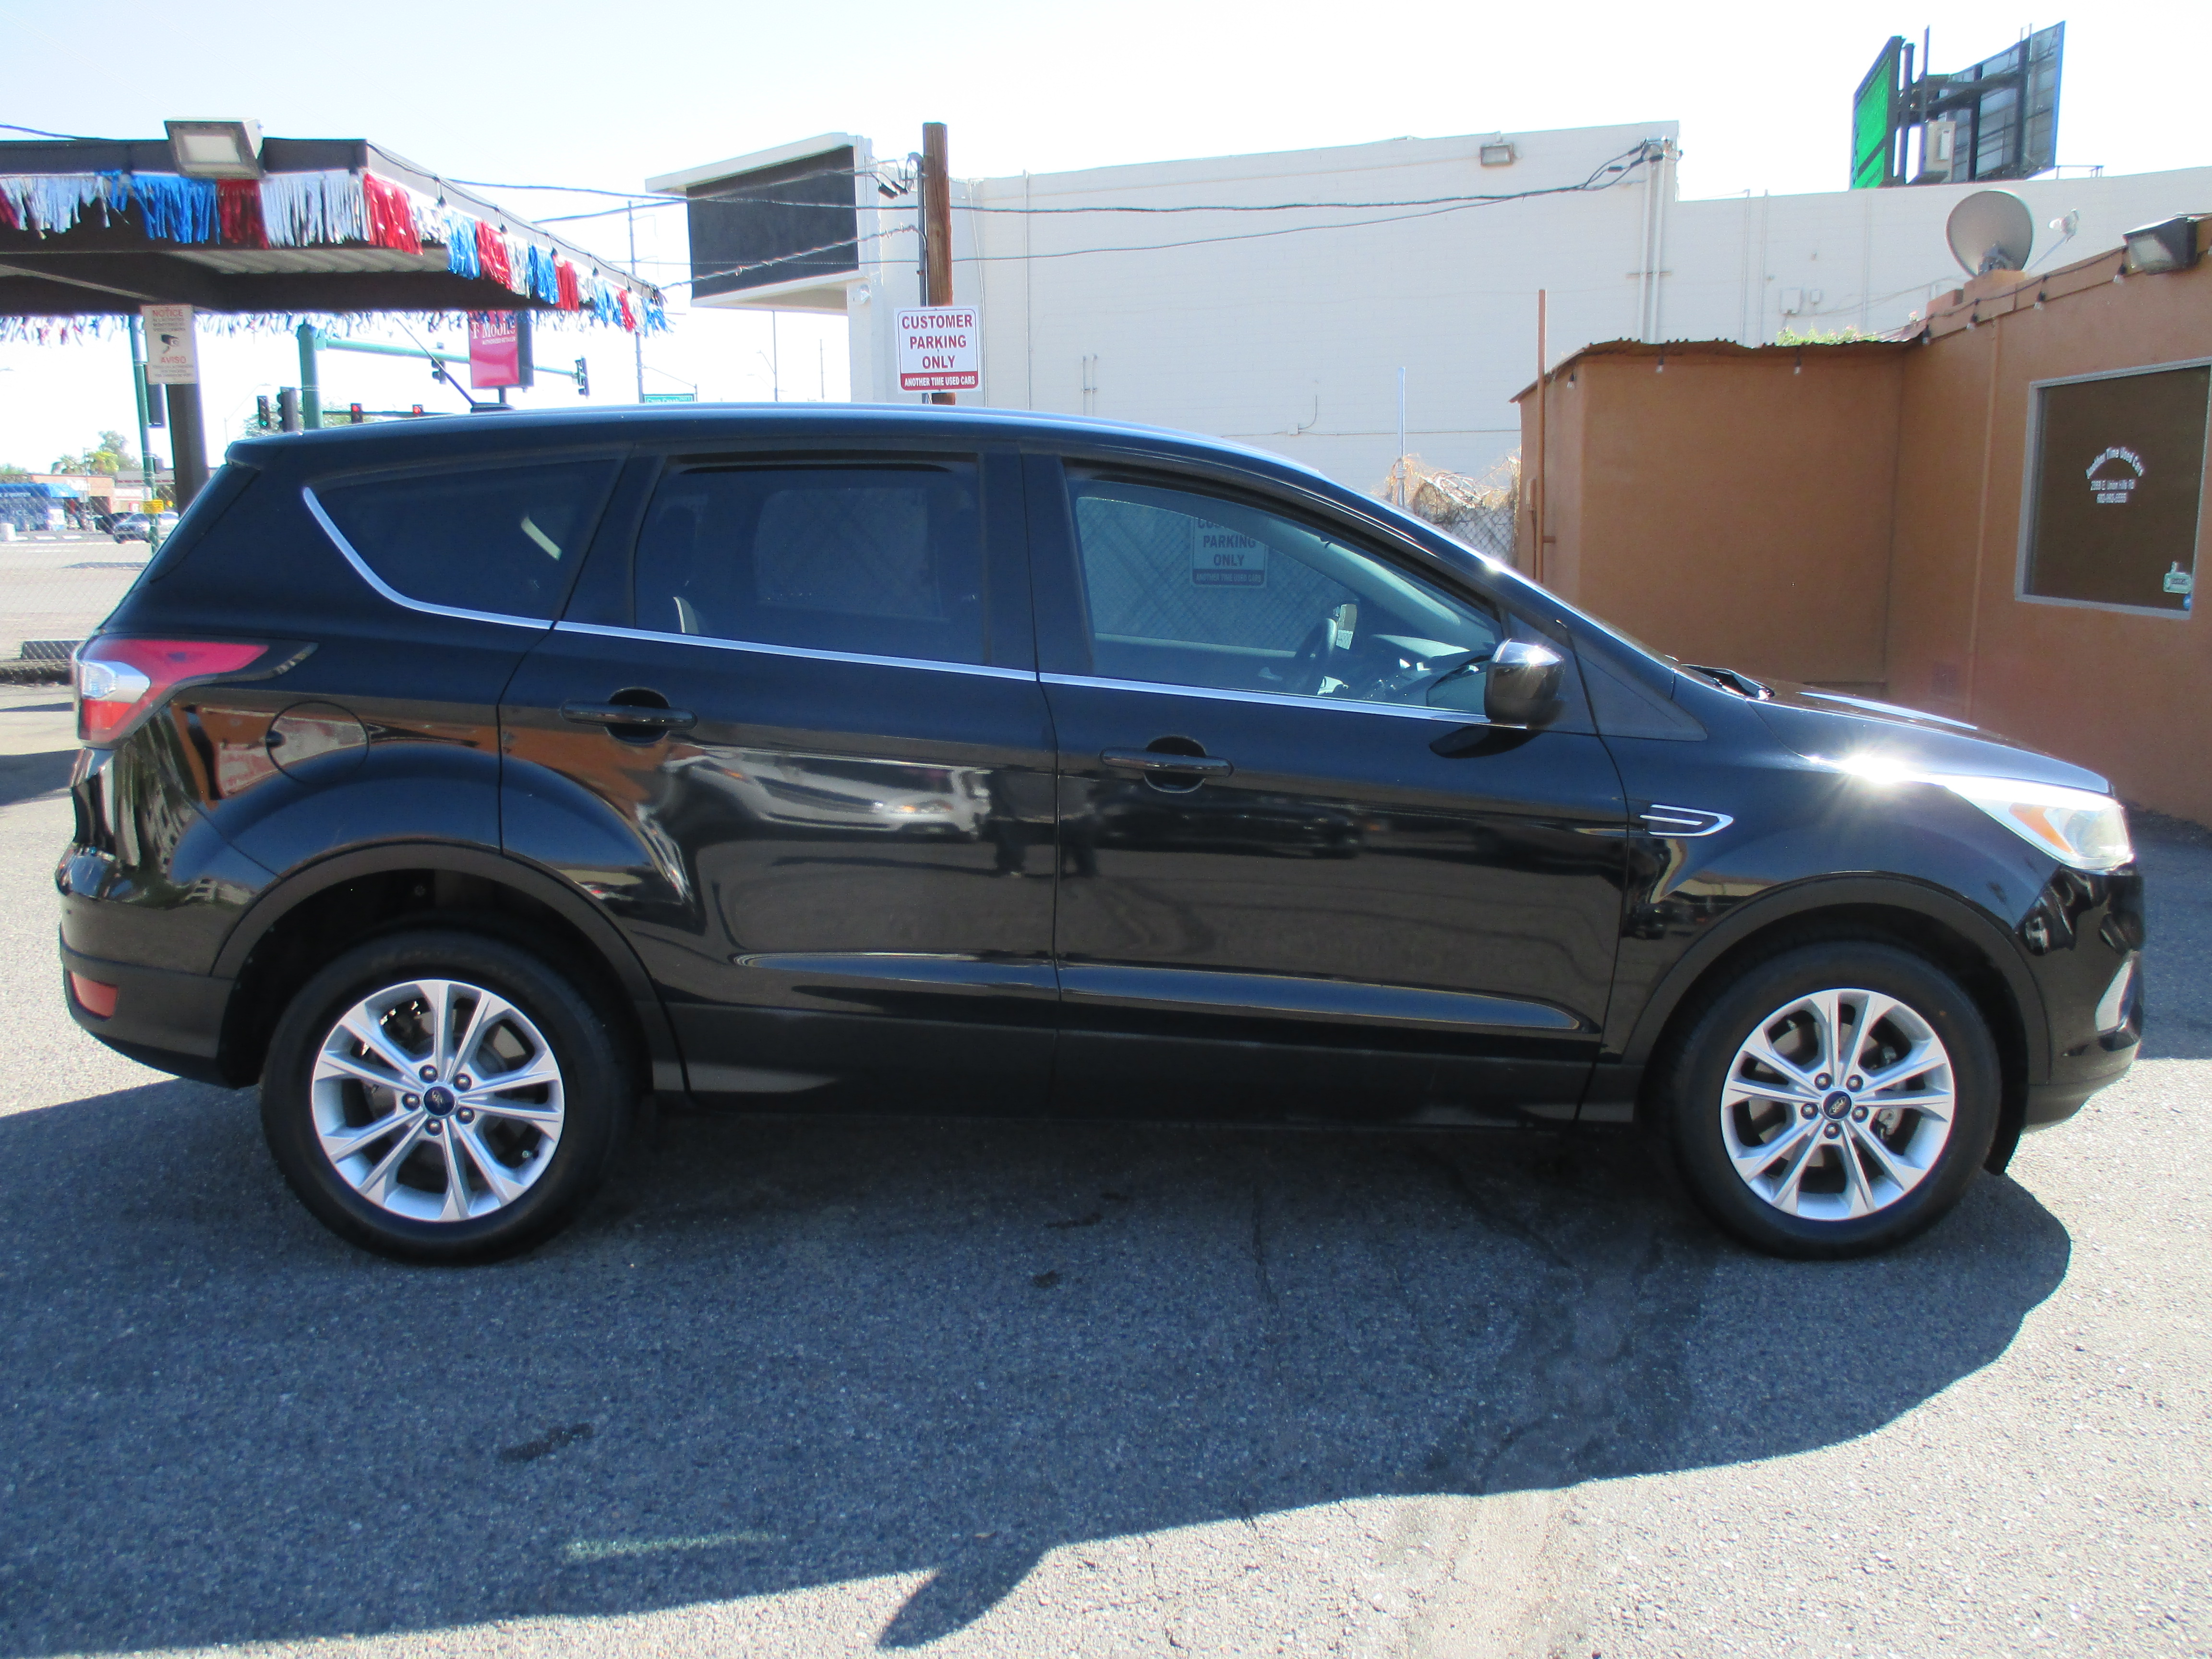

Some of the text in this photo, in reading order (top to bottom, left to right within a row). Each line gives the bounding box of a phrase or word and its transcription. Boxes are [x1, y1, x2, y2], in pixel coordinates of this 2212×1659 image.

[902, 314, 973, 329] CUSTOMER
[909, 335, 967, 349] PARKING
[922, 355, 956, 369] ONLY
[904, 375, 975, 387] ANOTHER TIME USED CARS
[1203, 535, 1256, 548] PARKING
[1214, 553, 1245, 566] ONLY
